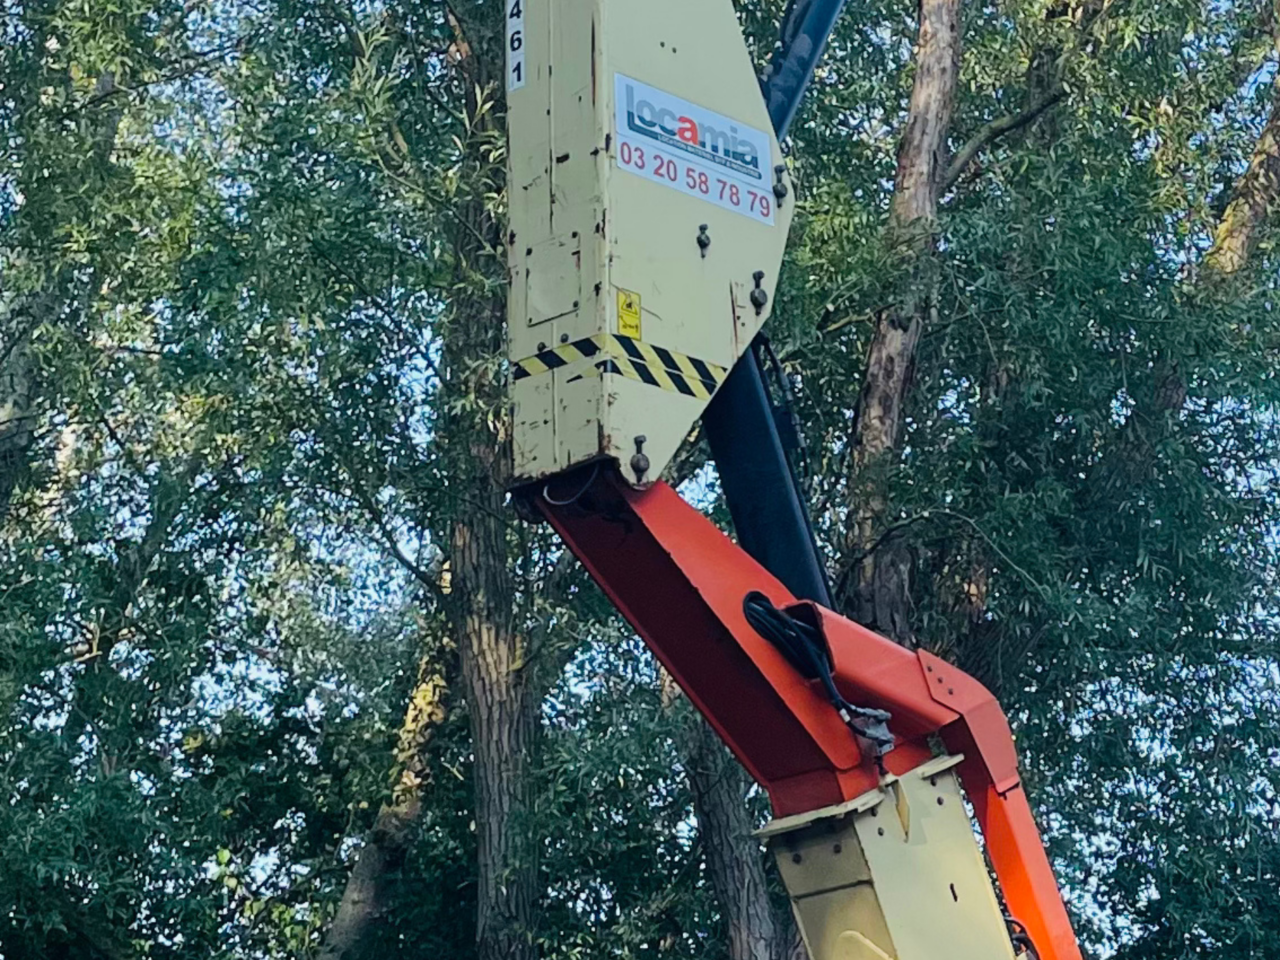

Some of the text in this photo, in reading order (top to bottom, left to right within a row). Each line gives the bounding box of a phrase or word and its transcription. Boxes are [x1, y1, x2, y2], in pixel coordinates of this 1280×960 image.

[625, 84, 759, 170] locamia
[620, 141, 646, 171] 03
[653, 154, 677, 182] 20
[686, 167, 710, 195] 58
[716, 178, 740, 207] 78
[747, 190, 771, 218] 79
